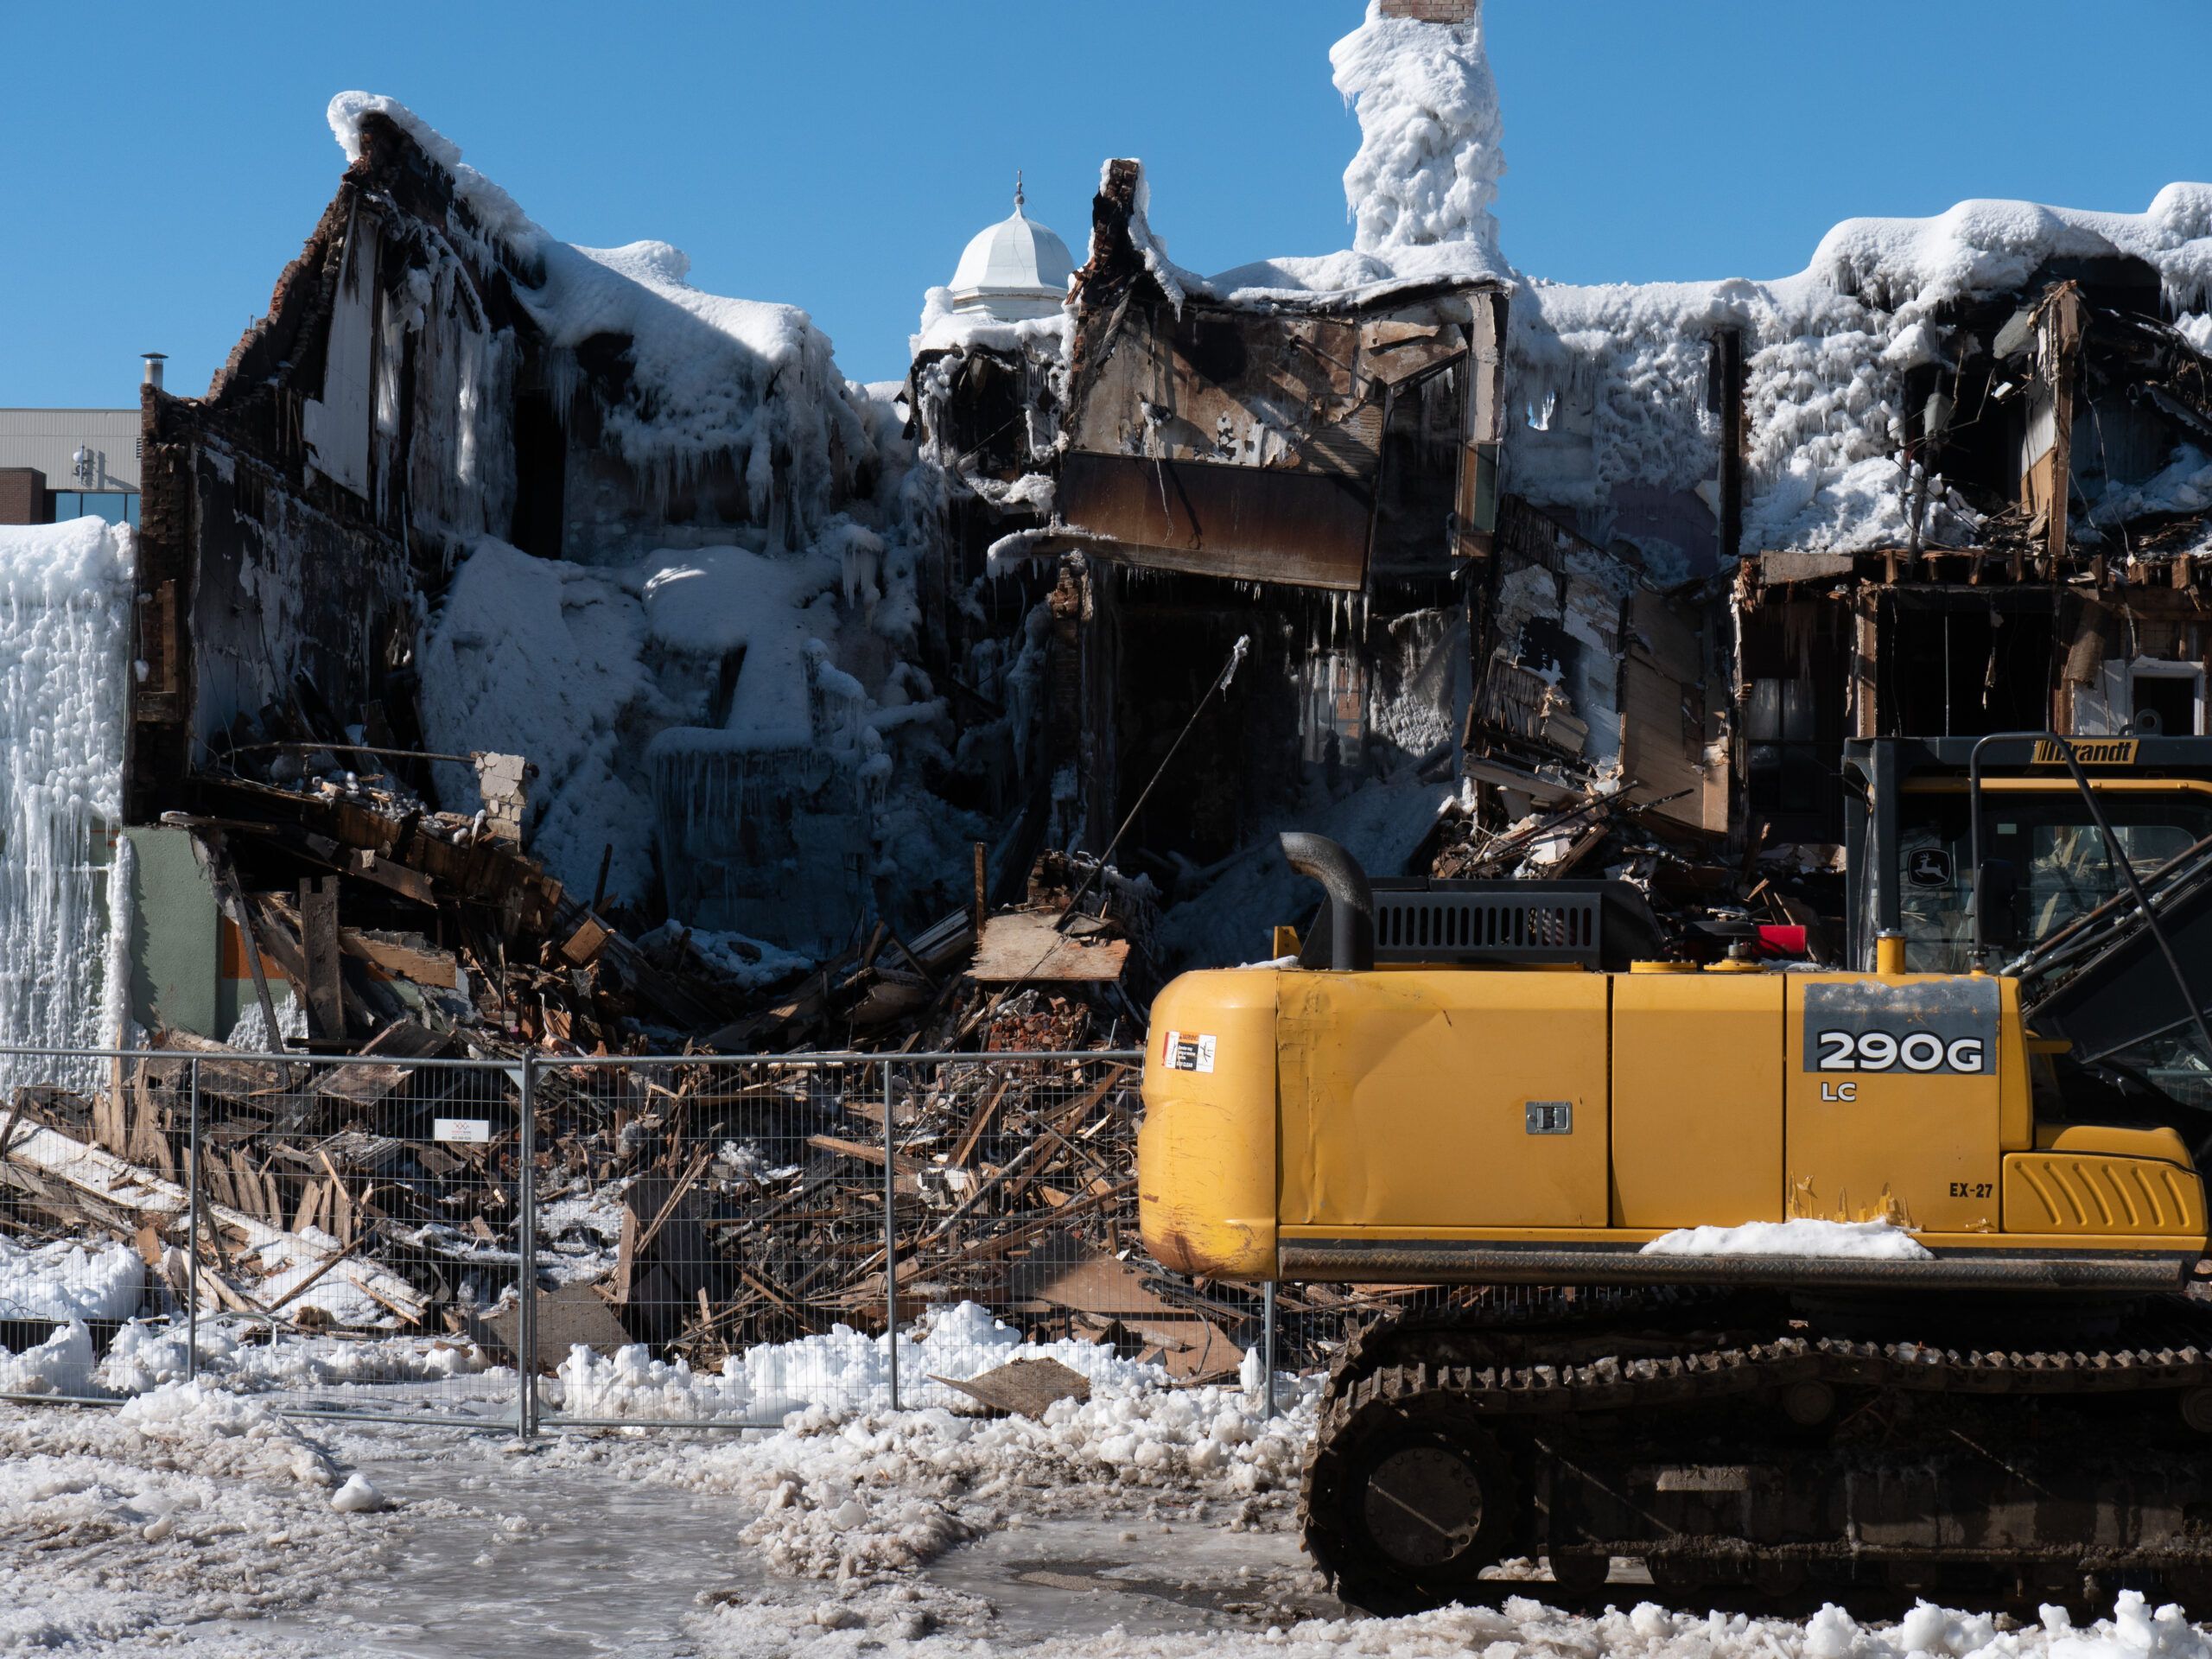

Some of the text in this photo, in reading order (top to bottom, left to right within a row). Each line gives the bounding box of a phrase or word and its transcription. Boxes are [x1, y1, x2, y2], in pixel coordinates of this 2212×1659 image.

[1817, 1028, 1985, 1074] 290G
[1821, 1081, 1857, 1103] LC
[1949, 1182, 1993, 1198] EX-27
